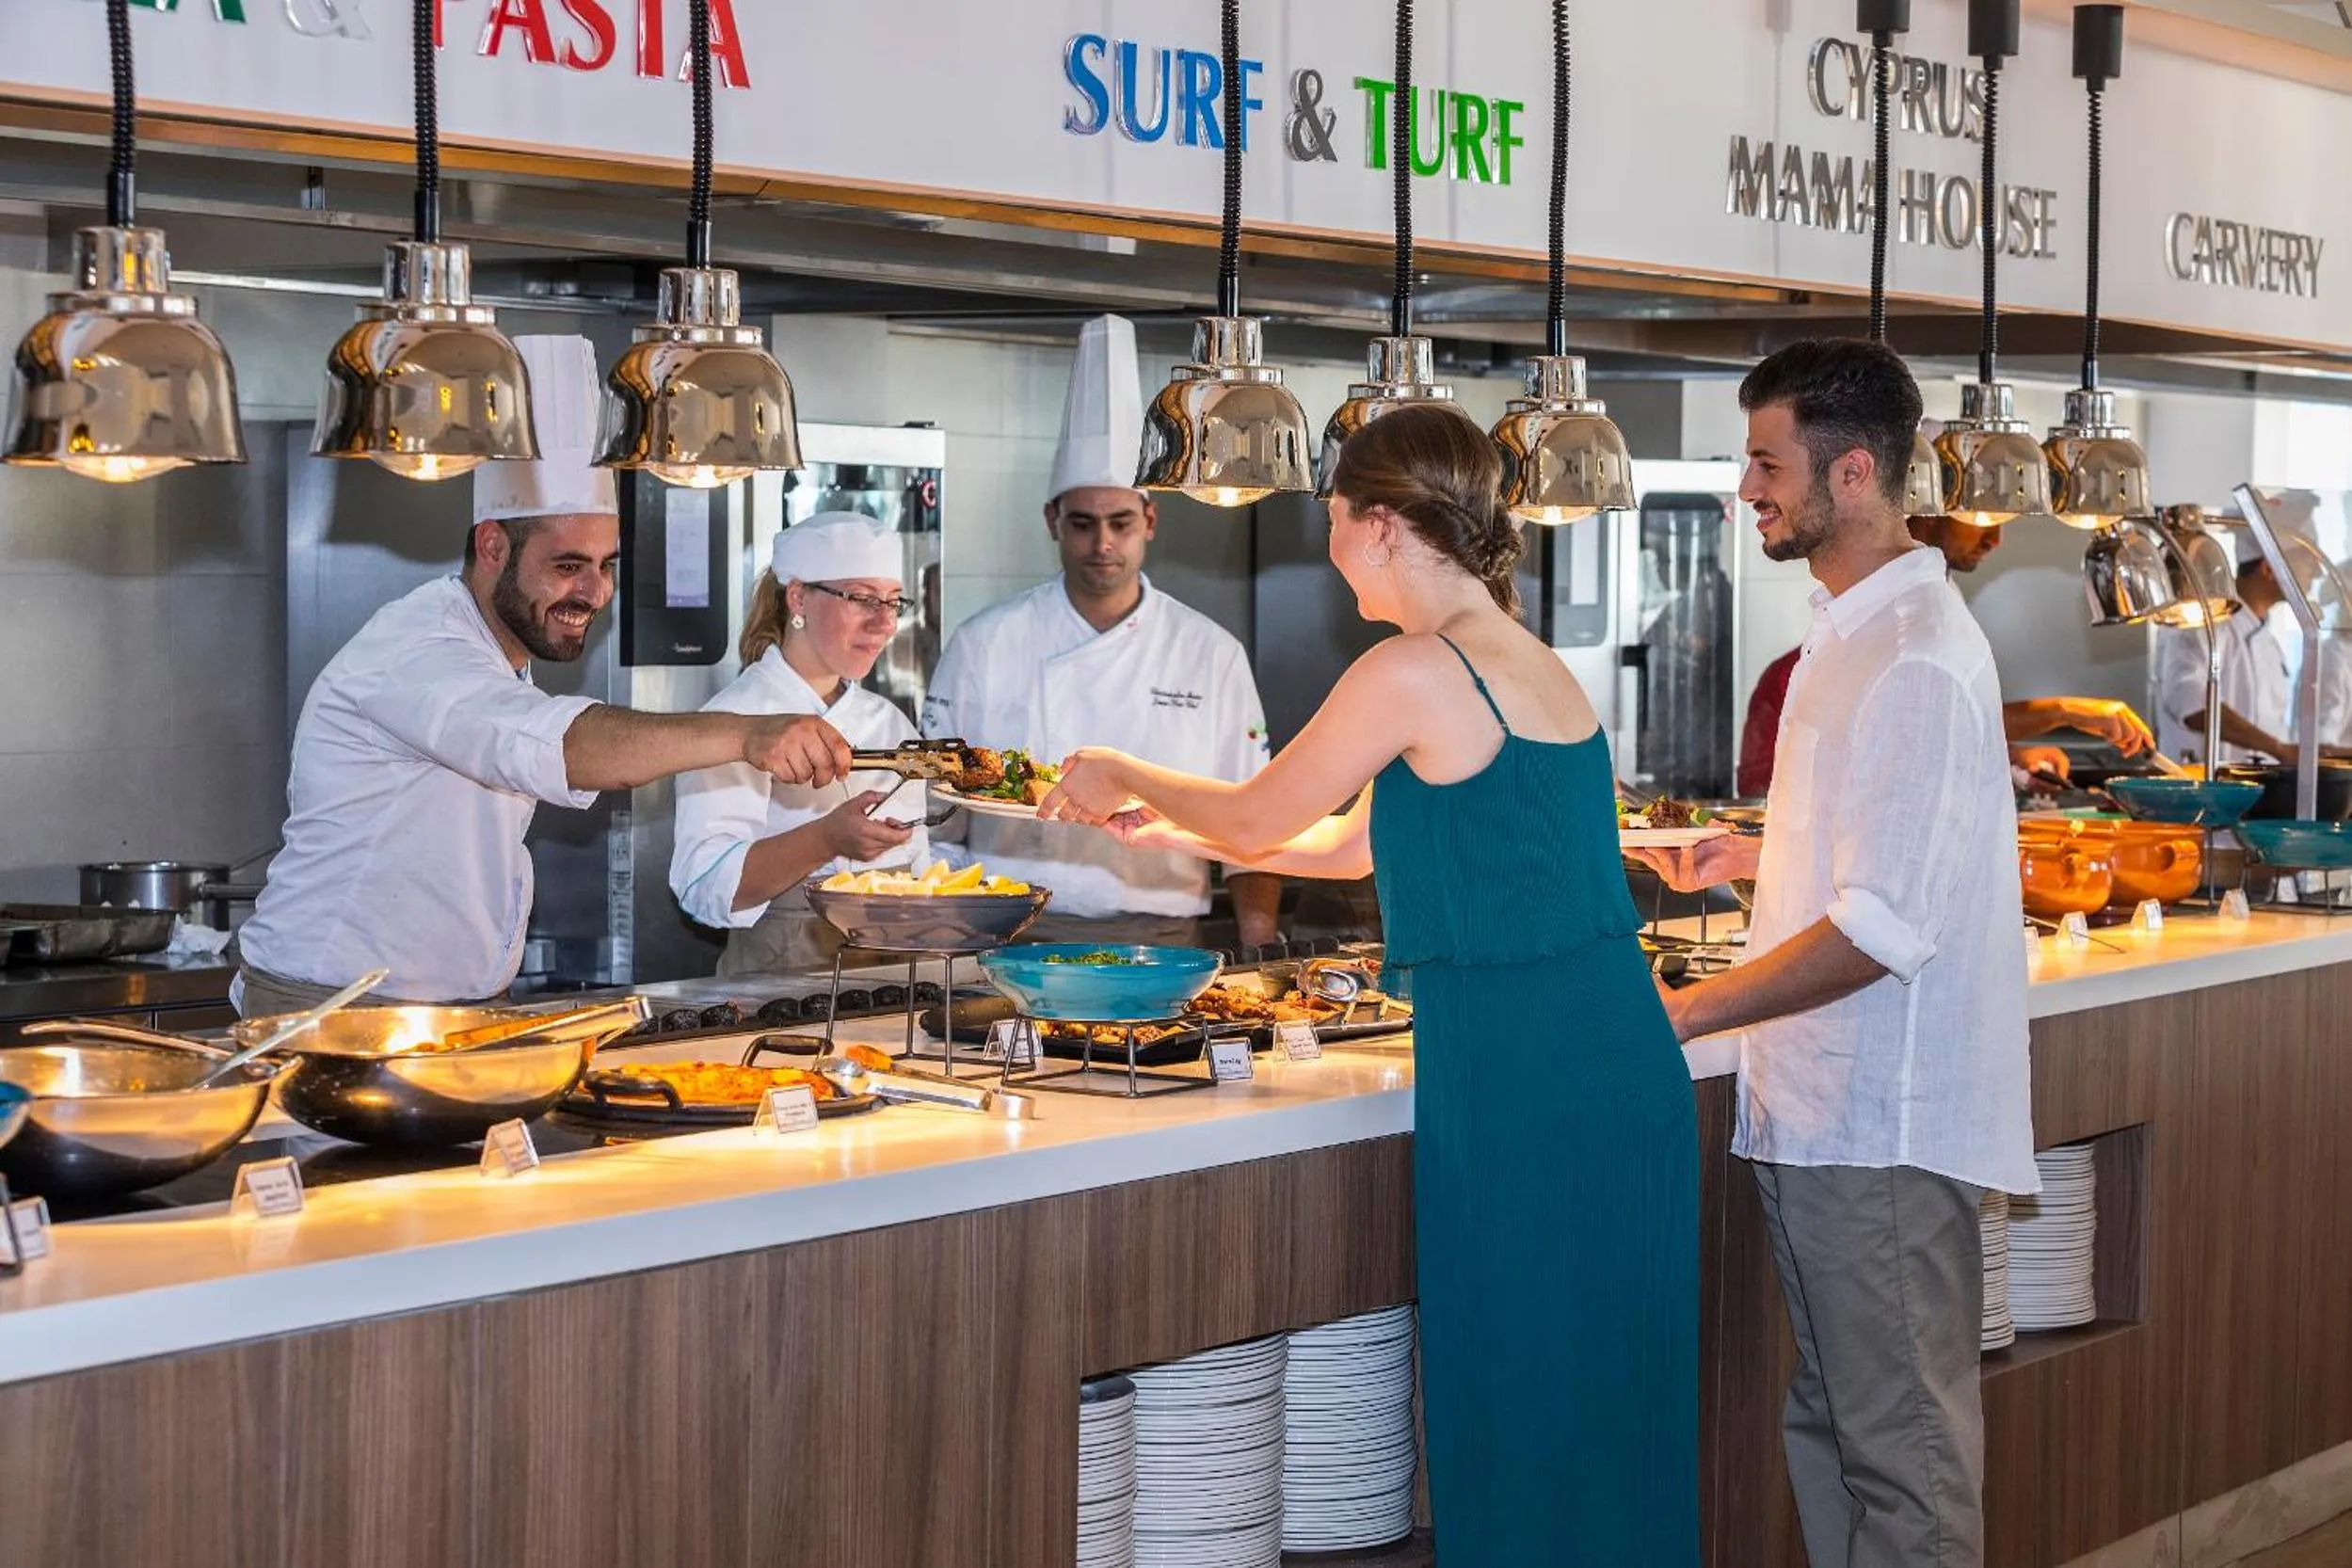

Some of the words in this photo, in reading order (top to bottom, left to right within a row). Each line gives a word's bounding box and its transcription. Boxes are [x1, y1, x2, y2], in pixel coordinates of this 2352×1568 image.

[1063, 33, 1263, 152] SURF
[1285, 68, 1337, 162] &
[1353, 76, 1524, 185] TURF
[2165, 212, 2323, 298] CARVERY
